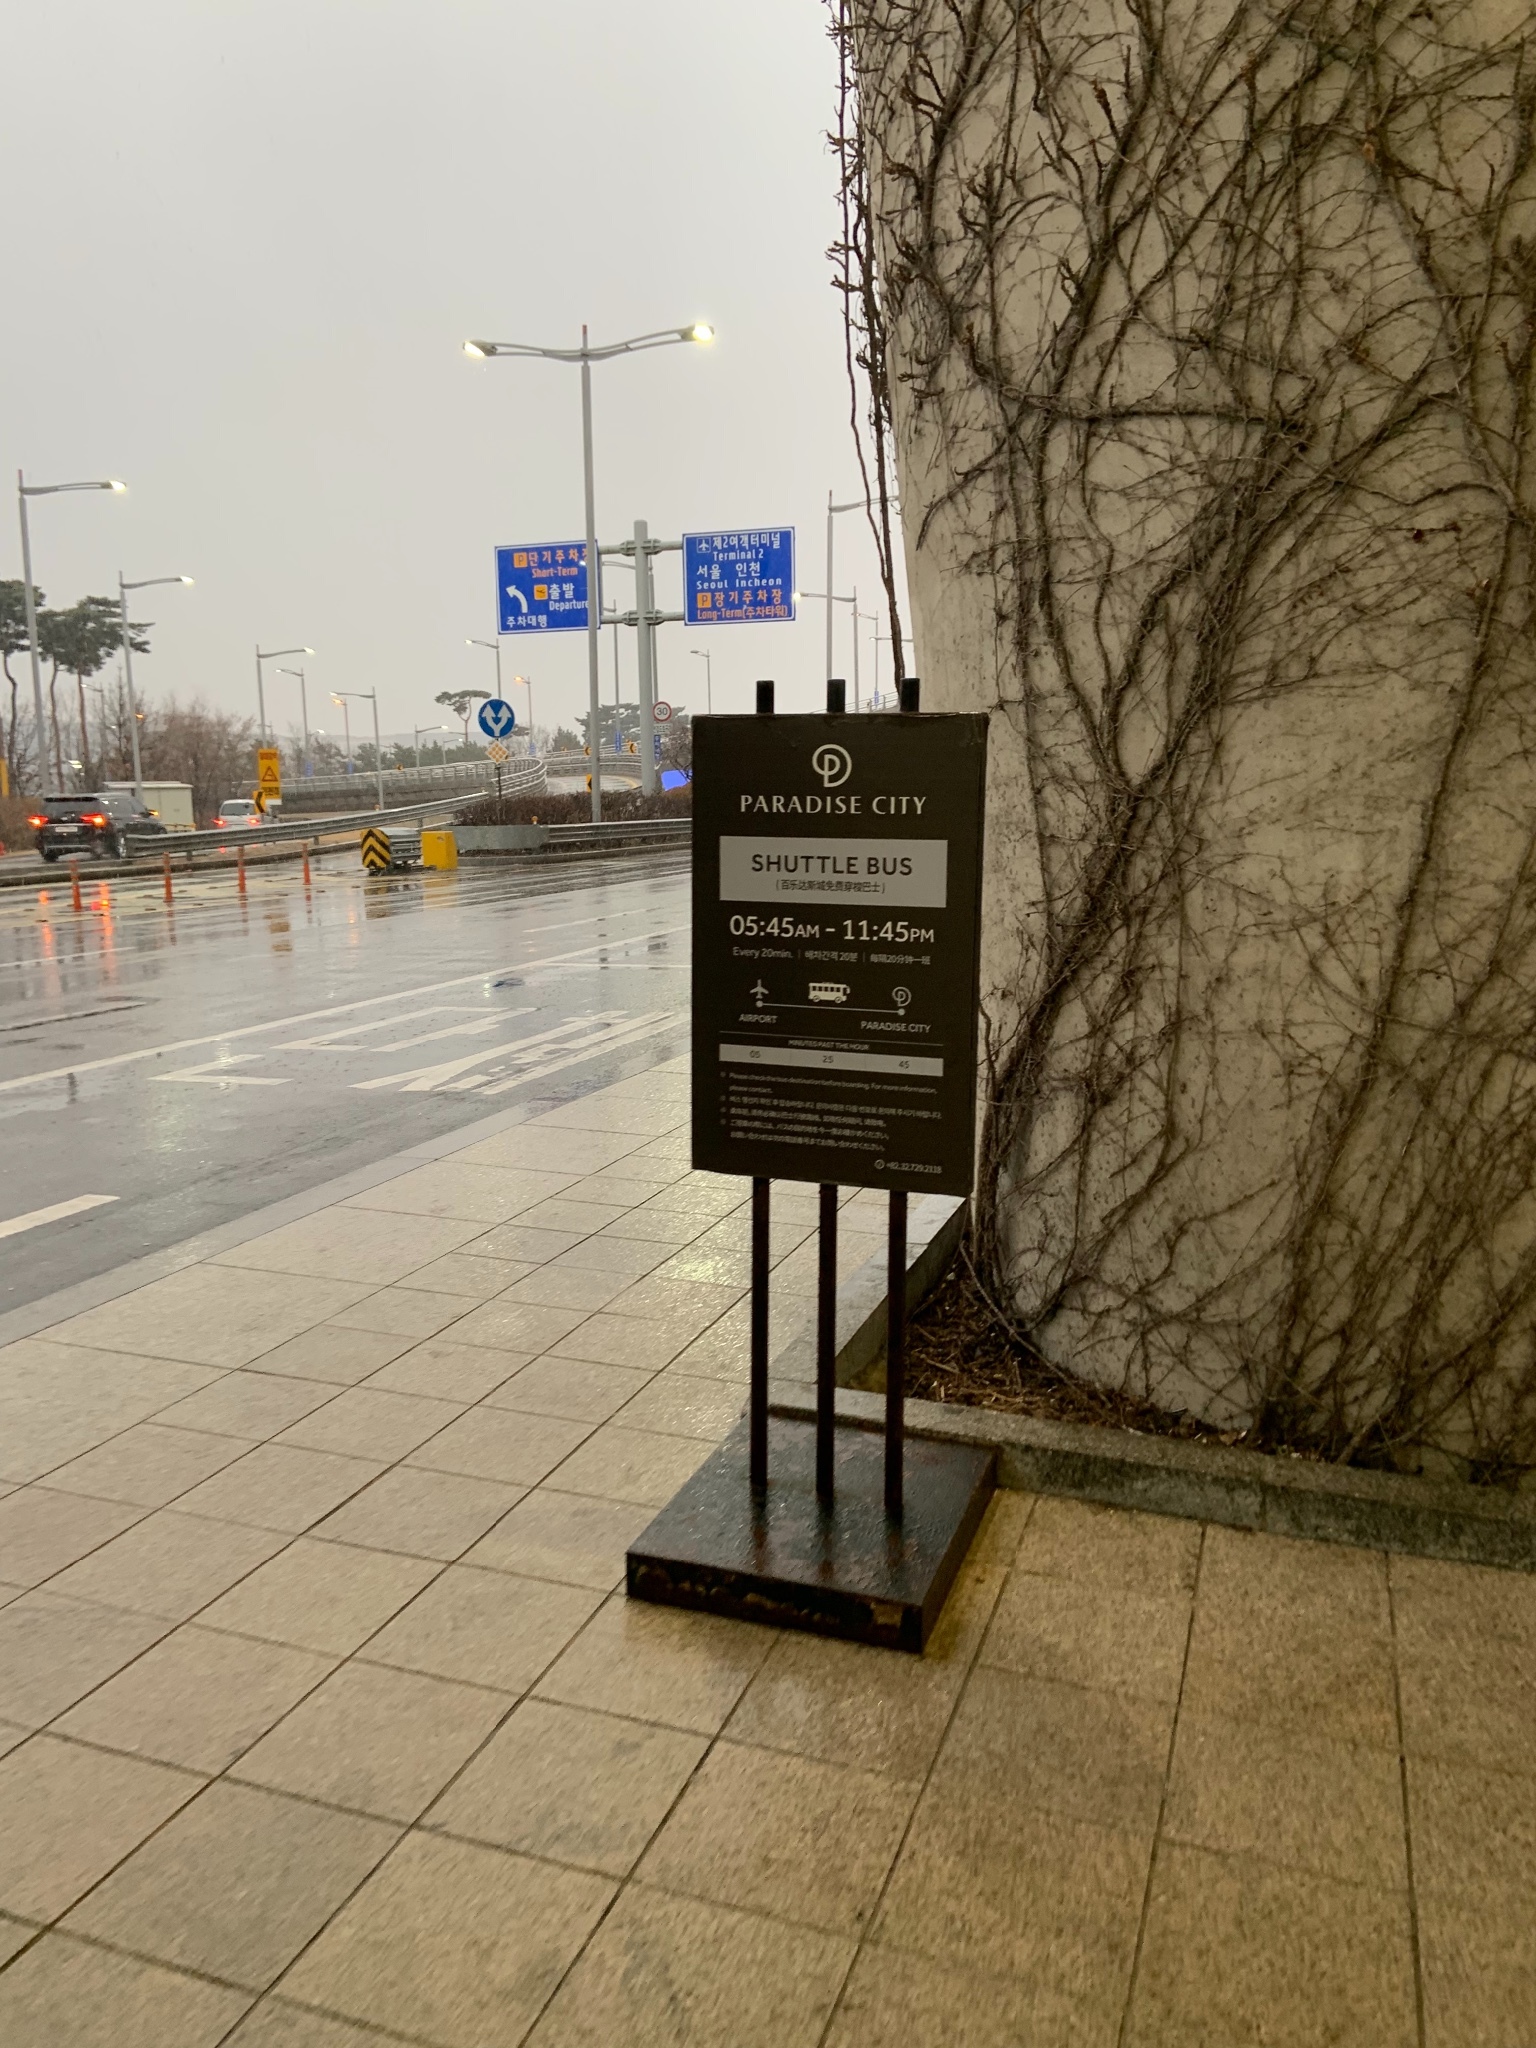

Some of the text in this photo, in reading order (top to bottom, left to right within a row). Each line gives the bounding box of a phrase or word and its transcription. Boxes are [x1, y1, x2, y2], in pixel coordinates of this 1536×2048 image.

[713, 532, 781, 549] 제2여객터미널
[713, 548, 764, 561] Terminal 2
[531, 566, 578, 578] Short-Term
[697, 561, 760, 579] 서울 인천
[697, 578, 782, 590] Seoul Incheon
[549, 583, 575, 600] 출발
[506, 614, 548, 628] 주차대행
[656, 707, 668, 716] 30
[740, 795, 926, 815] PARADISE CITY
[751, 854, 912, 876] SHUTTLE BUS
[729, 915, 820, 938] 05:45AM
[843, 919, 935, 943] 11:45PM
[732, 947, 759, 959] Every
[739, 1013, 778, 1023] AIRPORT
[861, 1021, 931, 1033] PARADISE CITY
[749, 1050, 761, 1059] 05
[822, 1055, 834, 1064] 25
[898, 1060, 910, 1069] 45
